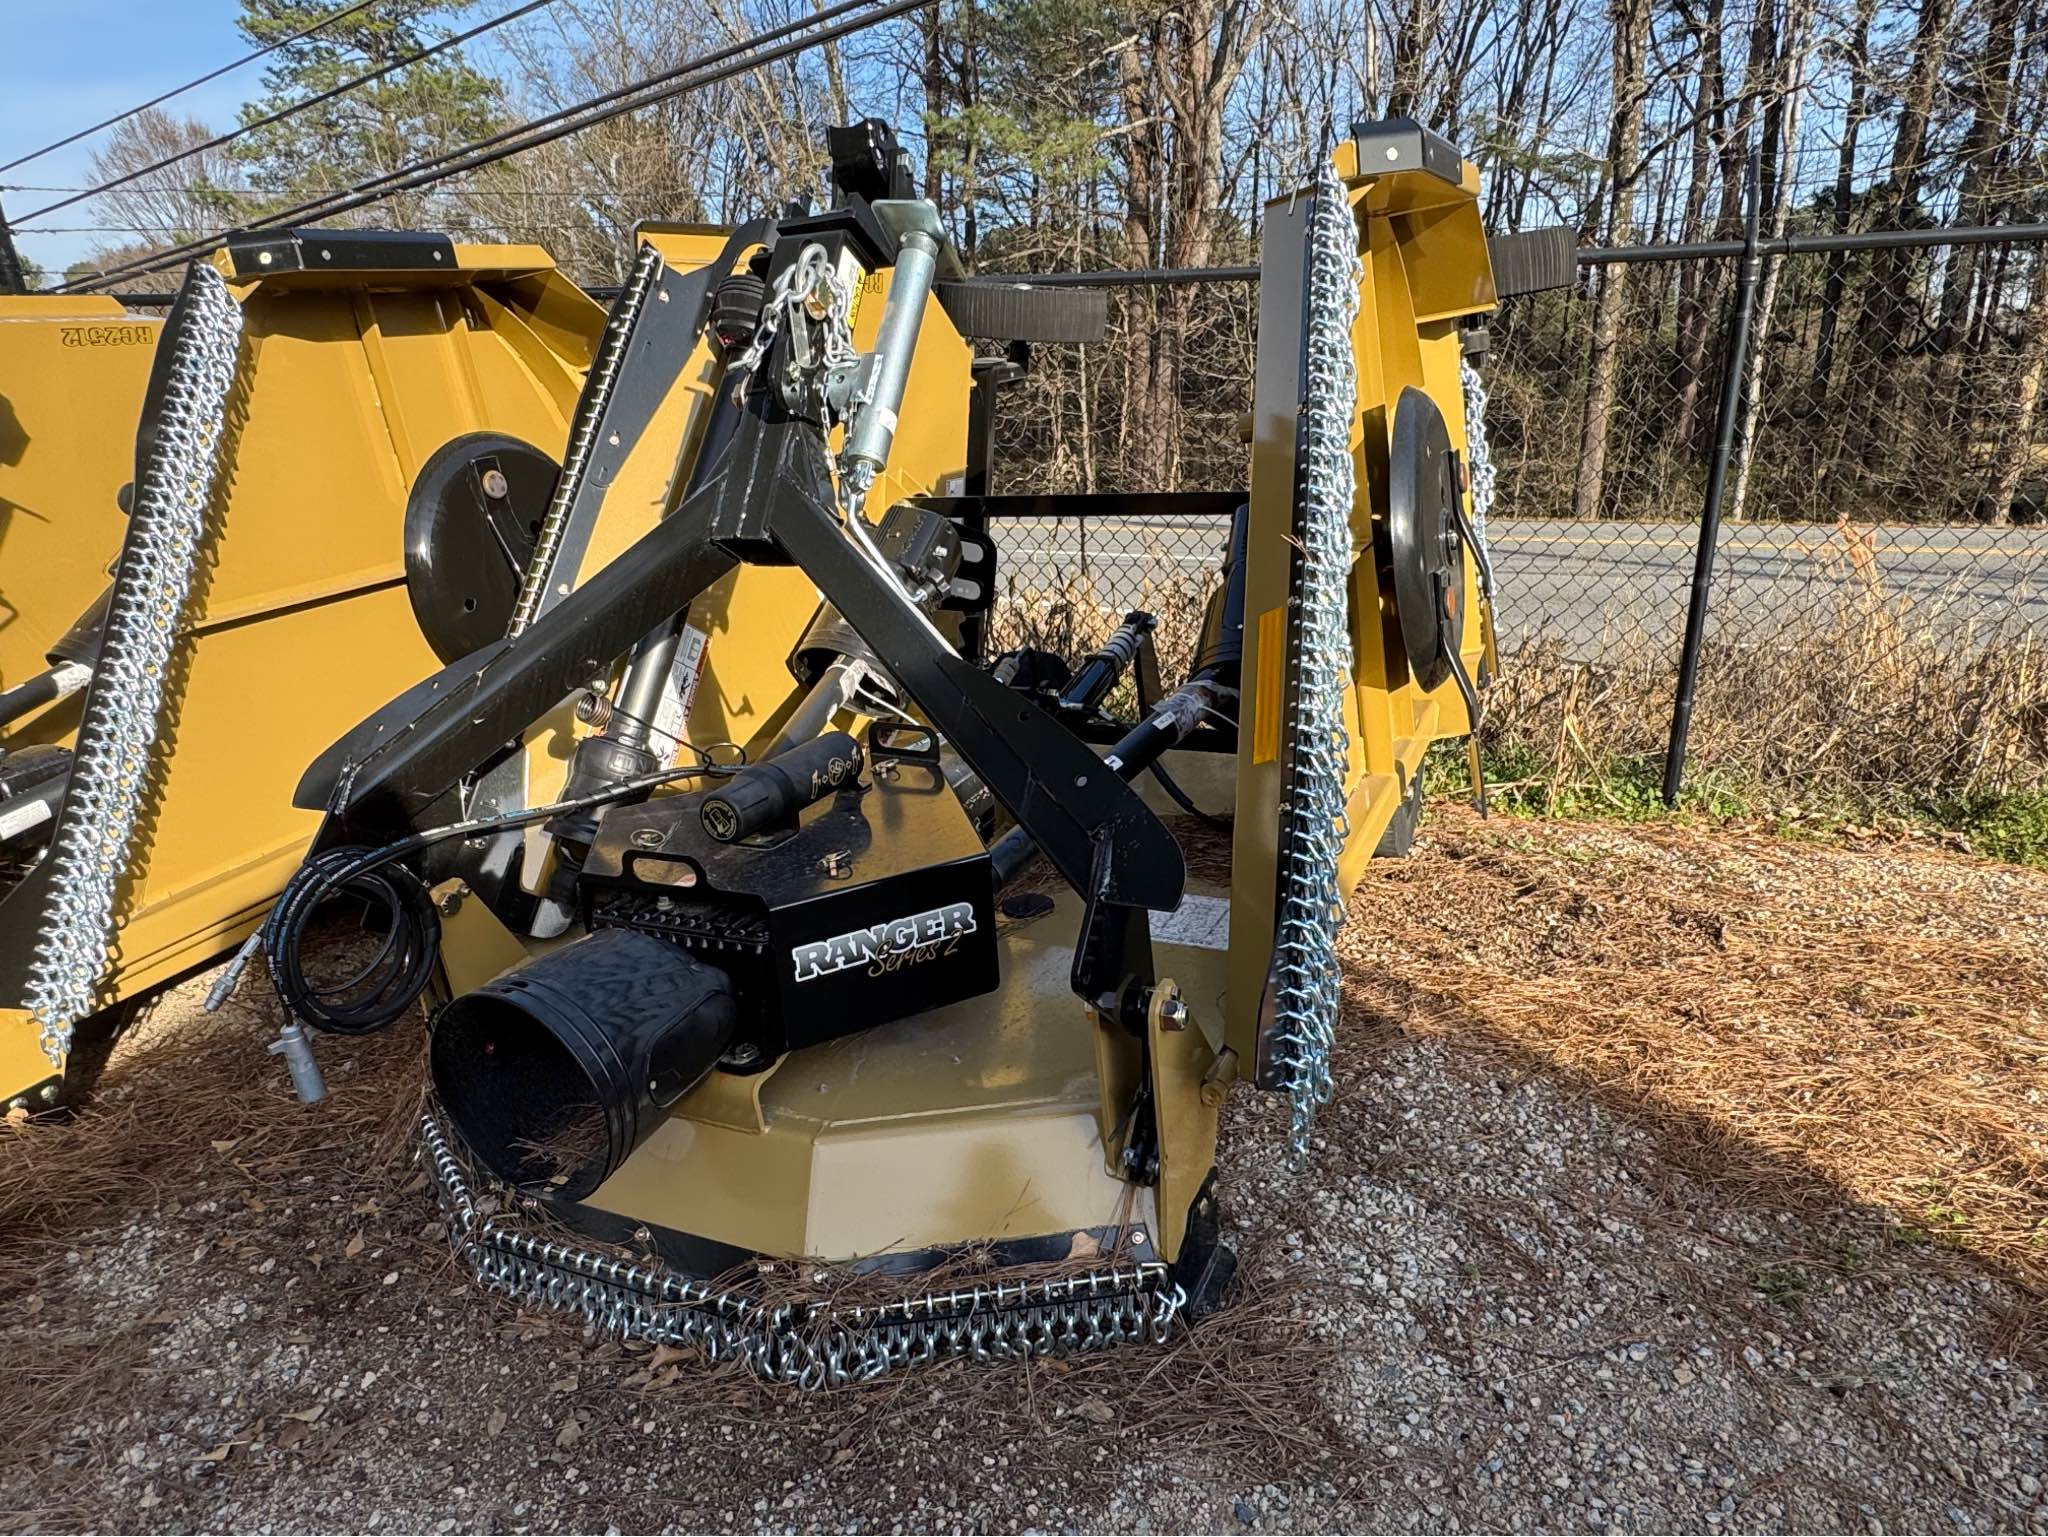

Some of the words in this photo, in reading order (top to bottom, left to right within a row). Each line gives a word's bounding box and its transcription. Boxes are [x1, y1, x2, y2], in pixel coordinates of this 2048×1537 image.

[60, 326, 154, 348] RC2512
[792, 902, 977, 982] RANGER
[868, 938, 941, 978] Series
[943, 929, 963, 956] 2
